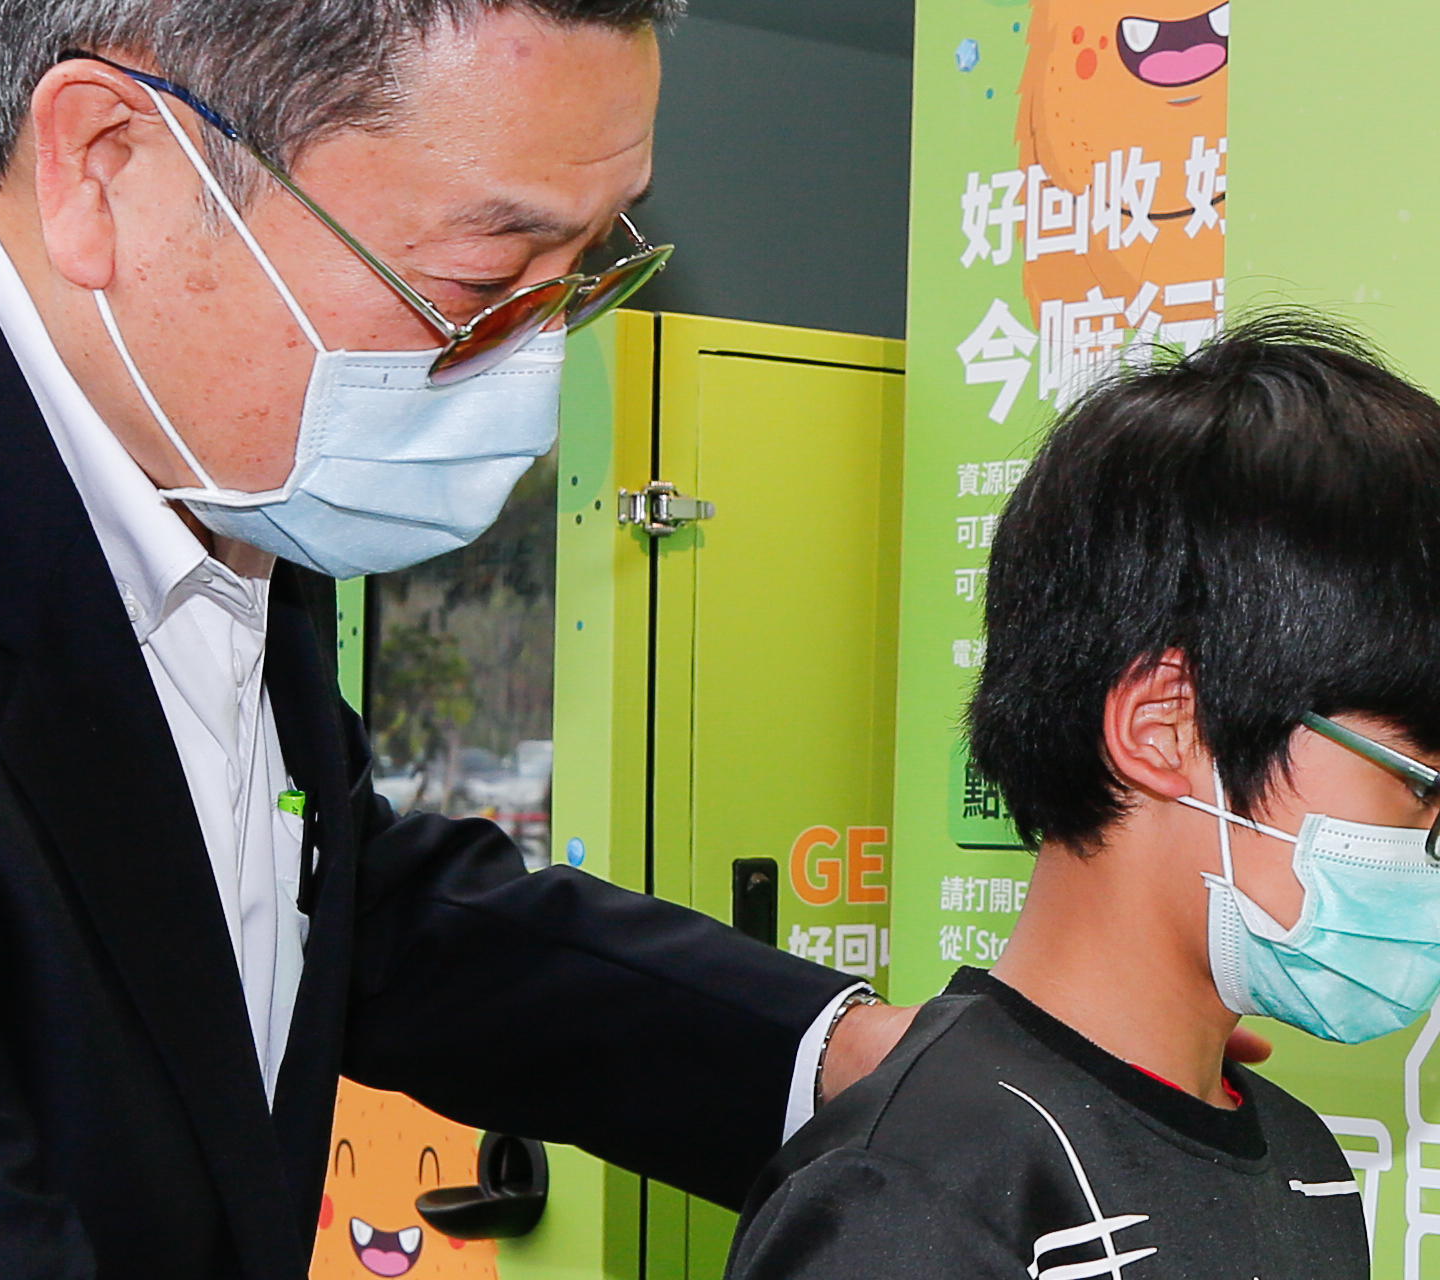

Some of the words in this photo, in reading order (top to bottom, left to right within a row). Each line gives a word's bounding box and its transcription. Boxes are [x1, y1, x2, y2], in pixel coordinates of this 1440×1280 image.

[961, 145, 1162, 269] 好回收
[956, 277, 1227, 426] 今嘛行
[789, 824, 888, 907] GE
[788, 923, 890, 978] 好回
